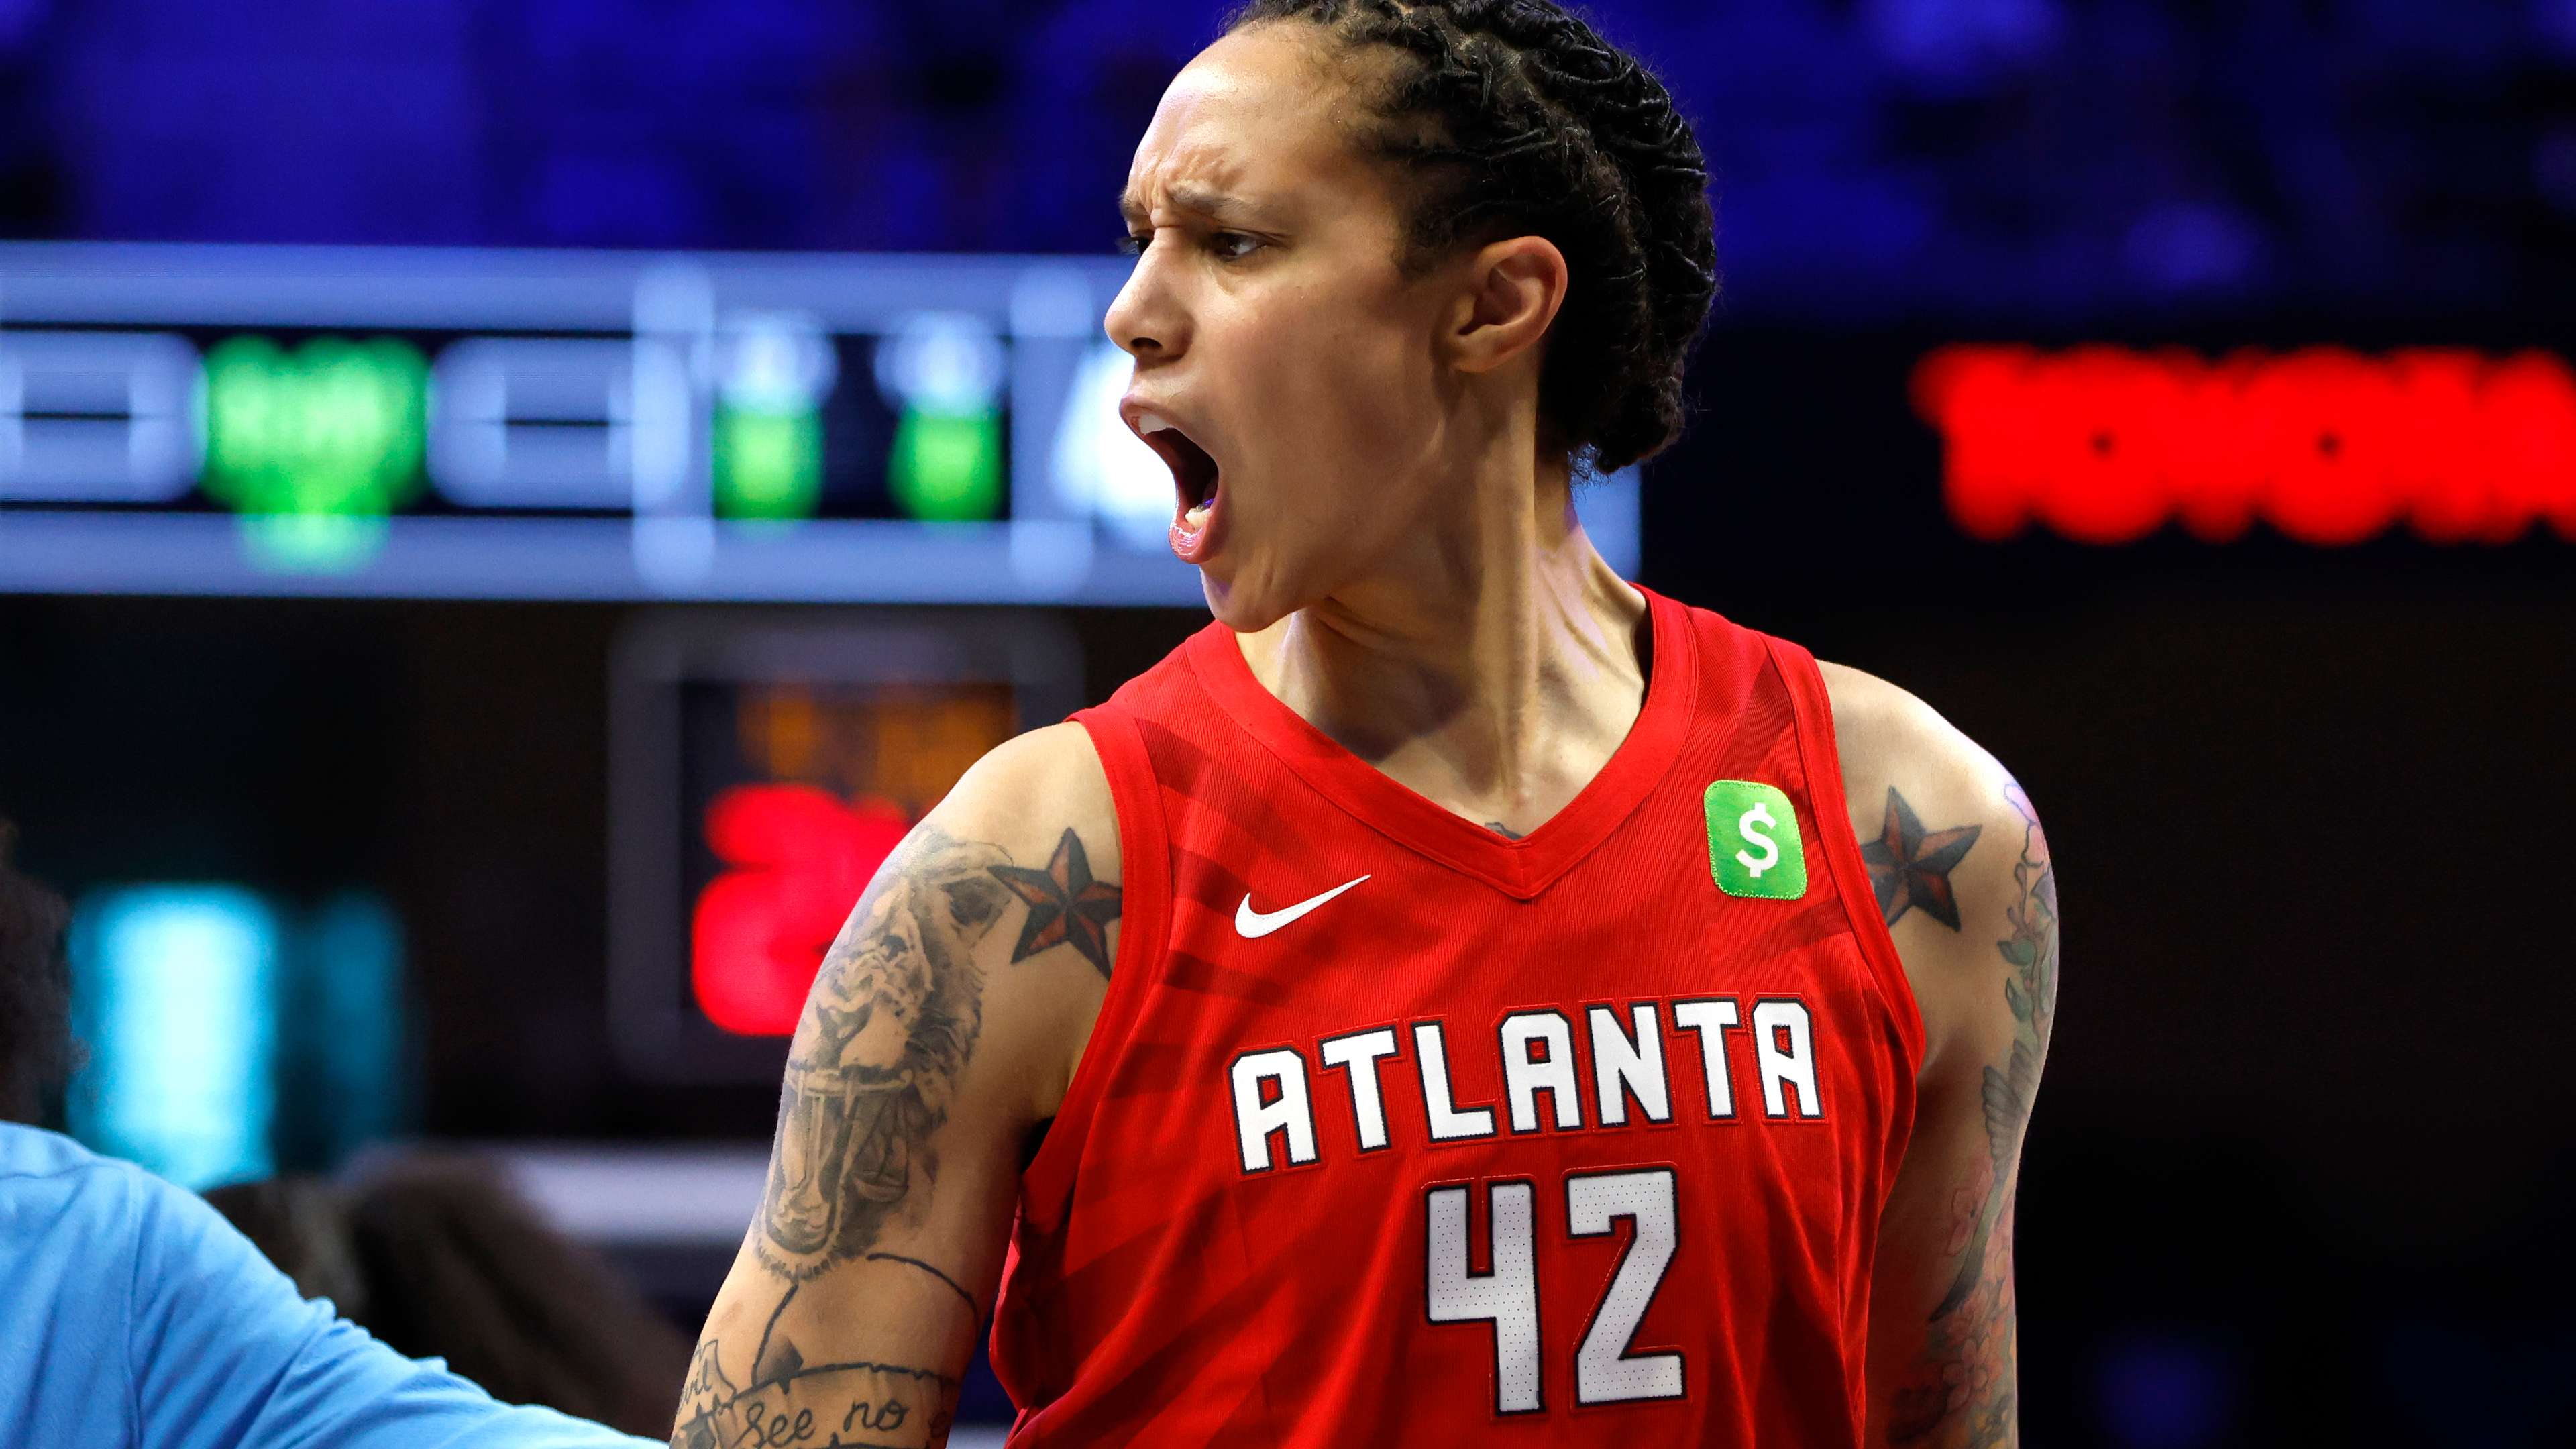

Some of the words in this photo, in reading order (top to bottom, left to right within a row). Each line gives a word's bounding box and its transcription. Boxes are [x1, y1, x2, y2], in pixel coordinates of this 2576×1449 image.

[1735, 802, 1778, 877] $
[1229, 996, 1825, 1175] ATLANTA
[1426, 1167, 1686, 1415] 42
[843, 1399, 910, 1432] no
